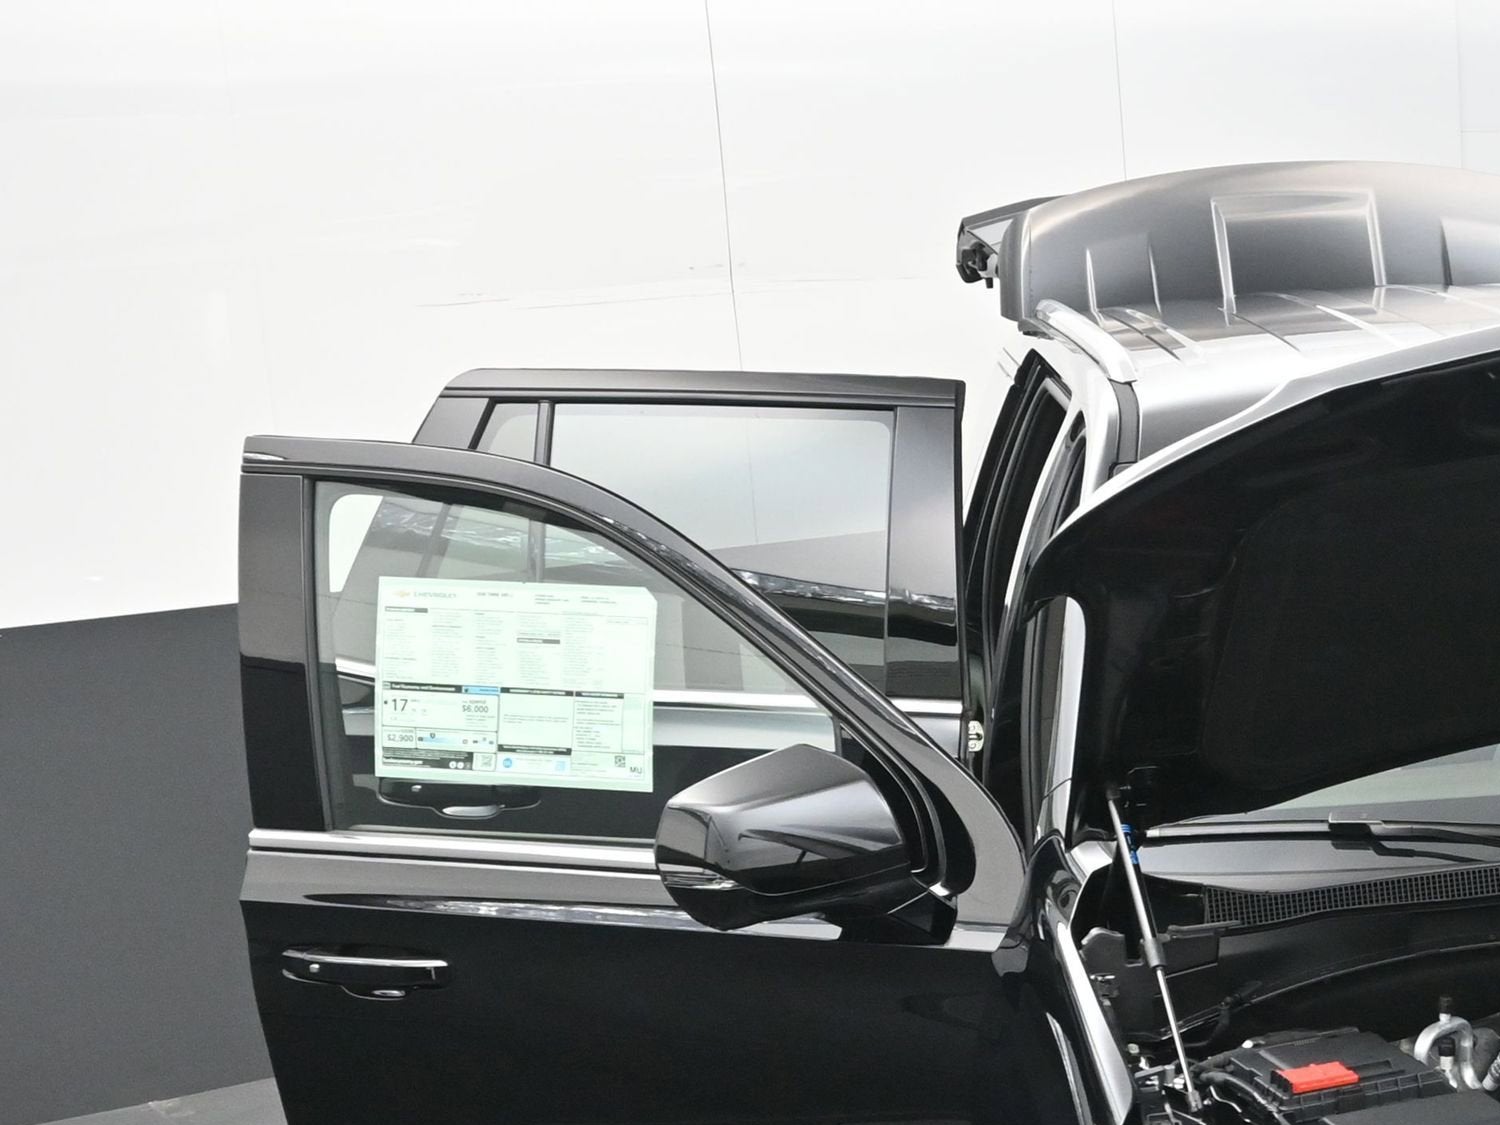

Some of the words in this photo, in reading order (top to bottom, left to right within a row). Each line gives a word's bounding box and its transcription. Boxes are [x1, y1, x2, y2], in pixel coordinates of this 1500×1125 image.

[391, 698, 408, 712] 17
[462, 705, 489, 713] $6,000
[387, 733, 414, 743] $2,900
